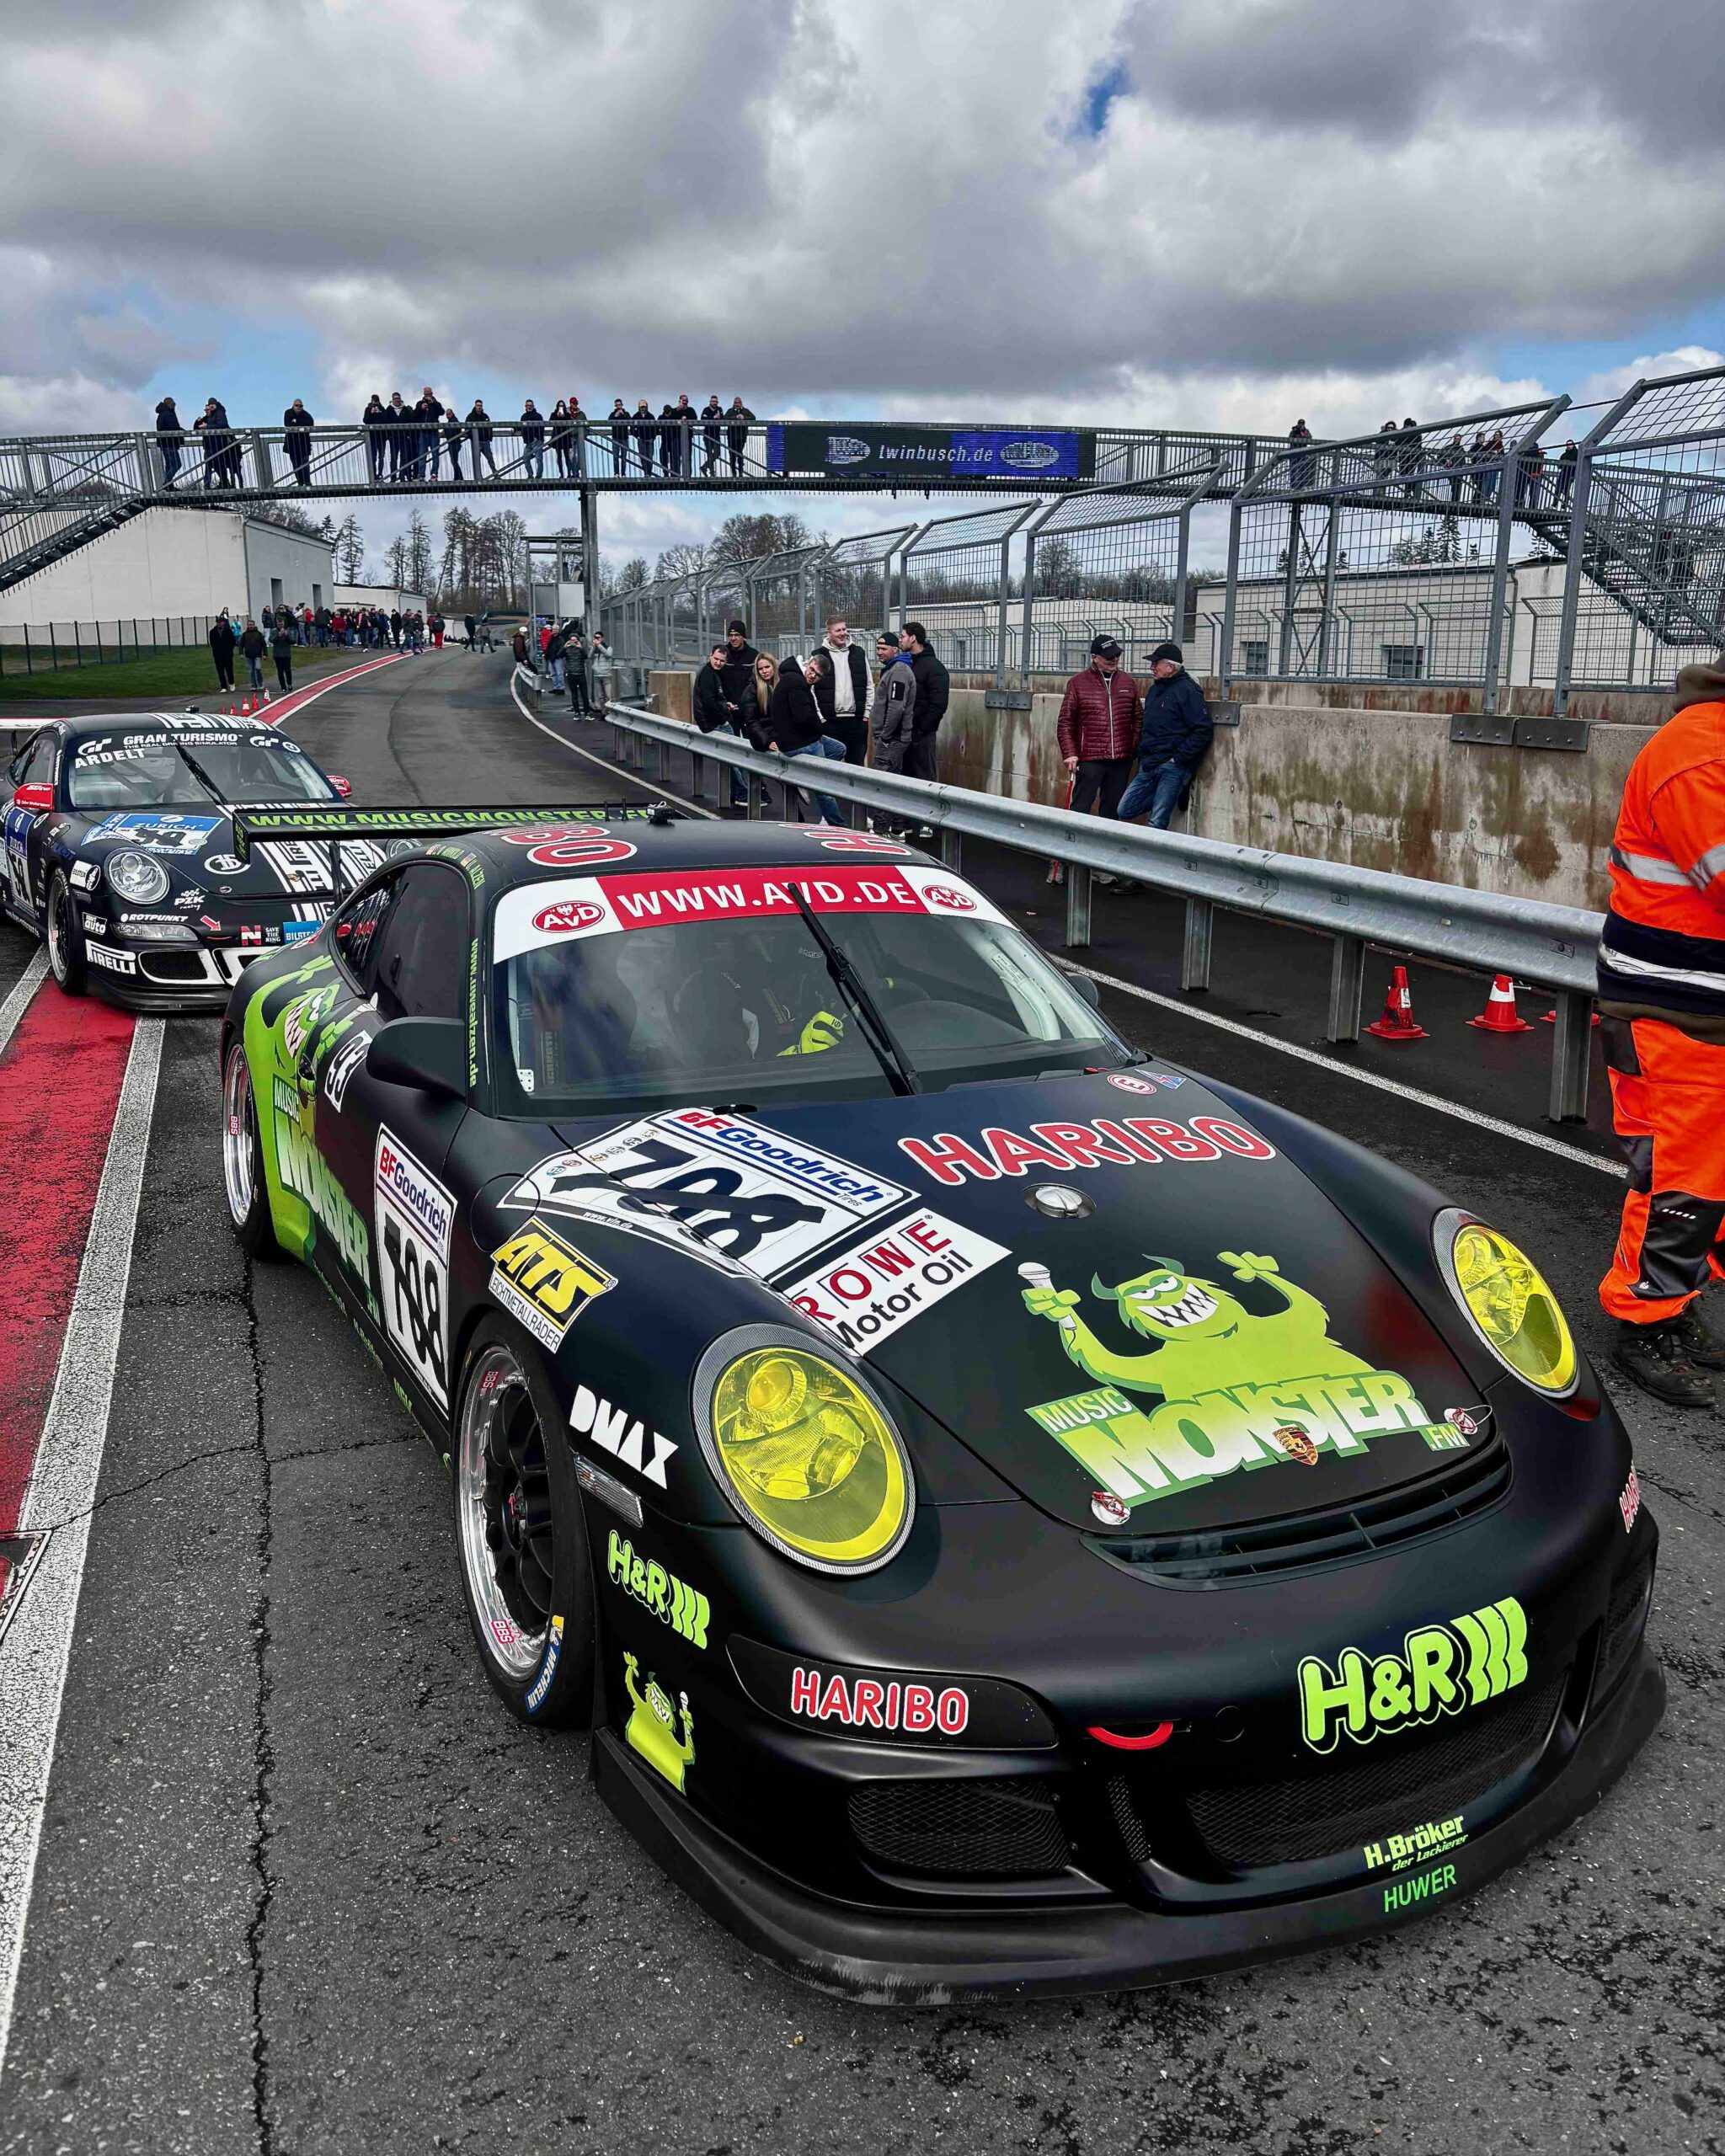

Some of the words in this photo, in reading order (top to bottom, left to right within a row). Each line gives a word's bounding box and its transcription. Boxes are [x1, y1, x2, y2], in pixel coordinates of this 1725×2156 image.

[75, 748, 145, 769] ARDELT
[123, 734, 167, 745] GRAN
[171, 733, 238, 744] TURISMO
[132, 822, 198, 832] ZURICH
[129, 914, 188, 922] ROTPUNKT
[174, 894, 206, 905] PZK
[617, 880, 916, 918] WWW.AVD.DE
[85, 919, 106, 933] auto
[85, 939, 136, 974] PIRELLI
[275, 1079, 300, 1123] MUSIC
[676, 1112, 884, 1203] BFGoodrich
[897, 1117, 1276, 1186] HARIBO
[275, 1108, 371, 1289] MONSTER
[379, 1145, 448, 1241] BFGoodrich
[837, 1193, 862, 1207] Tires
[493, 1232, 607, 1314] ATS
[791, 1221, 953, 1321] ROWE
[489, 1274, 561, 1352] LEICHTMETALLRÄDER
[836, 1282, 923, 1349] Motor
[921, 1250, 974, 1285] Oil
[482, 1370, 499, 1390] BBS
[1038, 1387, 1134, 1433] MUSIC
[569, 1385, 678, 1490] DMAX
[1059, 1375, 1432, 1500] MONSTER
[609, 1529, 670, 1624] H&R
[492, 1620, 513, 1643] BBS
[528, 1652, 557, 1710] MICHELIN
[792, 1667, 969, 1735] HARIBO
[1298, 1625, 1465, 1753] H&R
[1363, 1815, 1464, 1870] H.Bröker
[1391, 1857, 1414, 1871] der
[1416, 1834, 1469, 1863] Lackierer
[1384, 1864, 1457, 1913] HUWER
